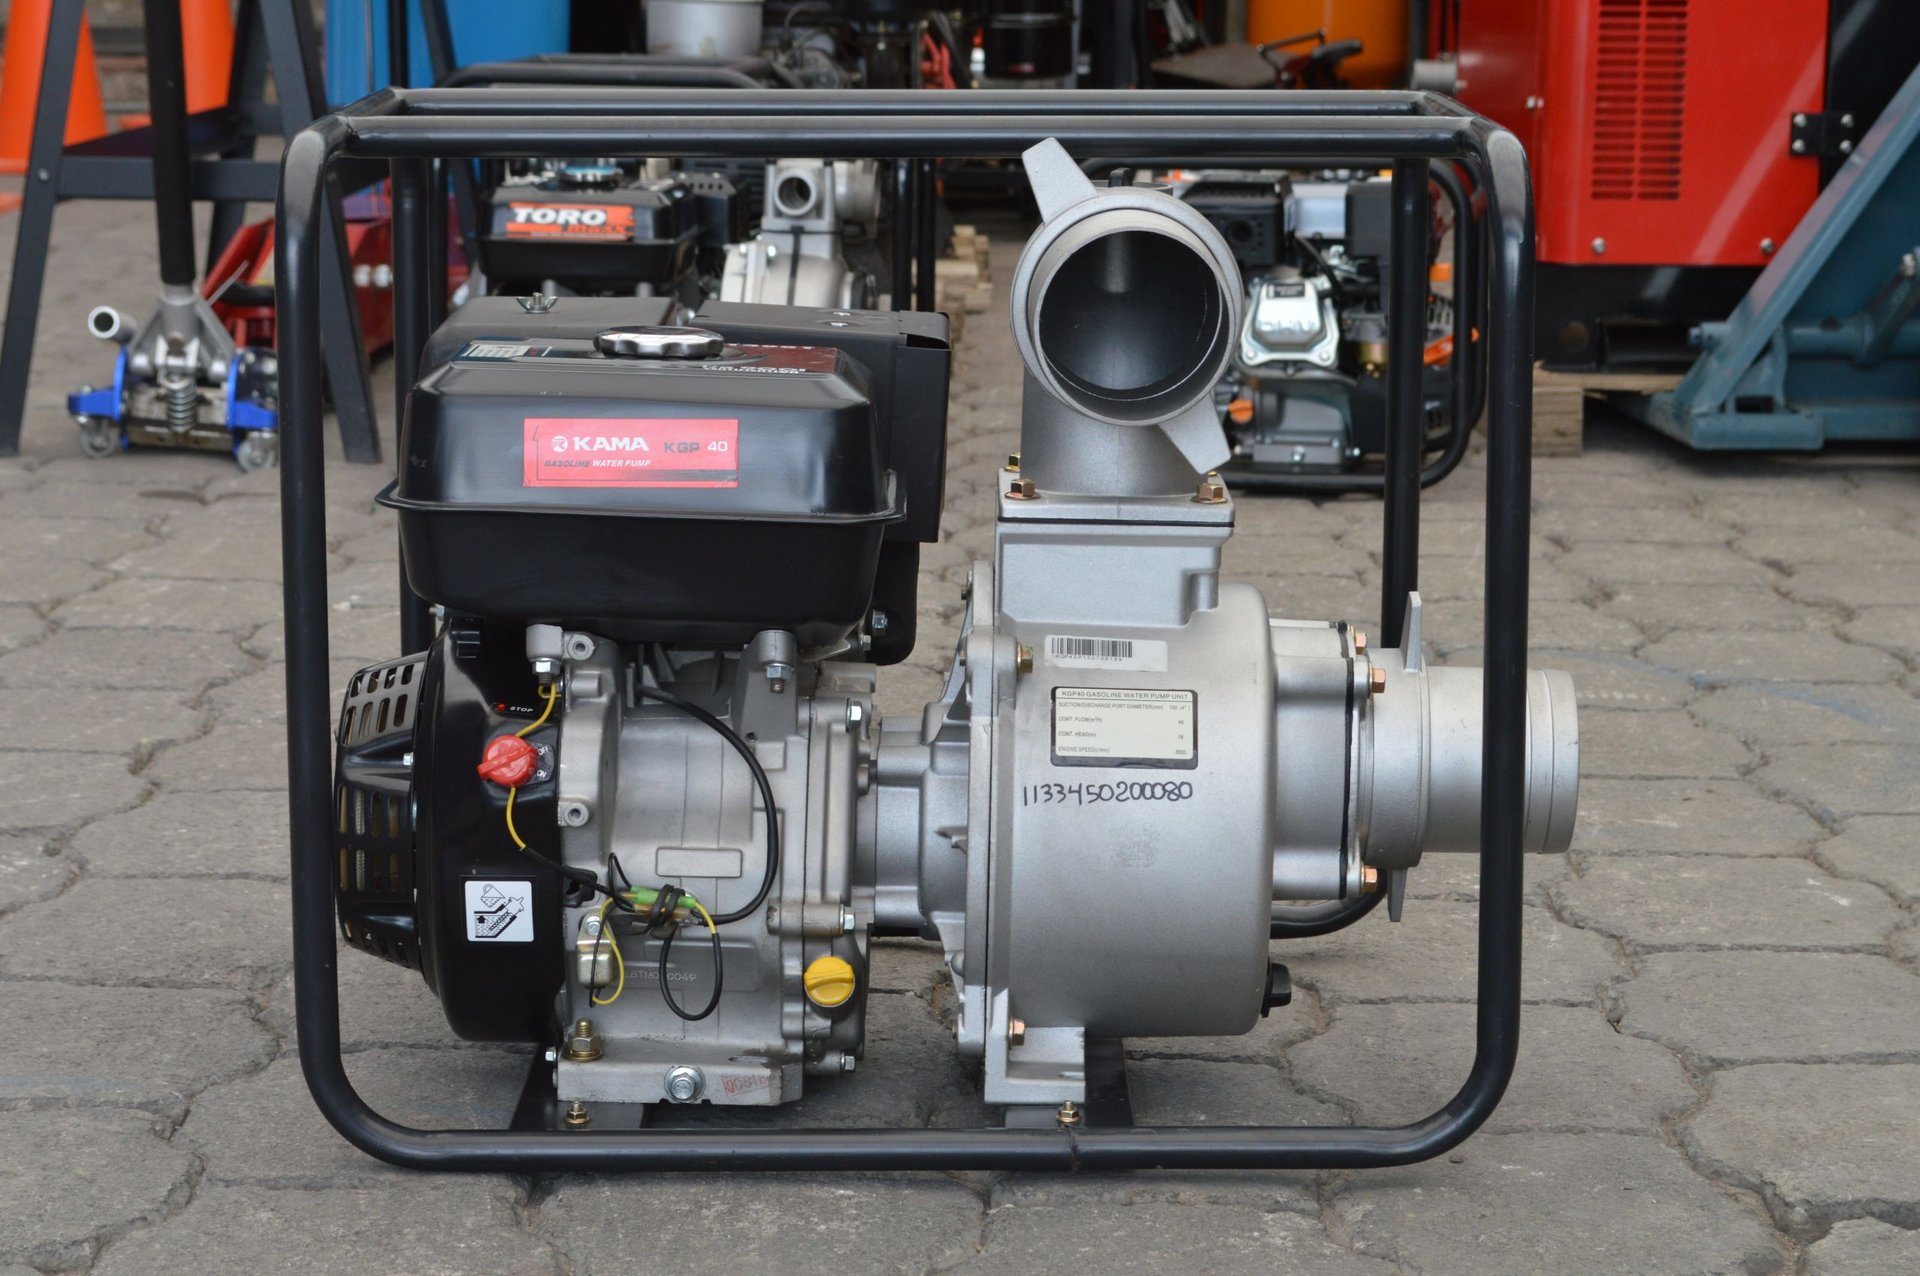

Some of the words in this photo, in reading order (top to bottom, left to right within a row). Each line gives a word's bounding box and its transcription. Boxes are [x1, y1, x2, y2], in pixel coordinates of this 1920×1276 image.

[514, 208, 606, 225] TORO
[573, 436, 649, 451] KAMA
[664, 441, 700, 453] KGP
[707, 441, 728, 452] 40
[544, 459, 590, 467] GASOLINE
[592, 459, 624, 467] WATER
[625, 459, 651, 467] PUMP
[538, 746, 549, 755] OFF
[537, 770, 547, 778] ON
[1024, 781, 1193, 806] 1133450200080
